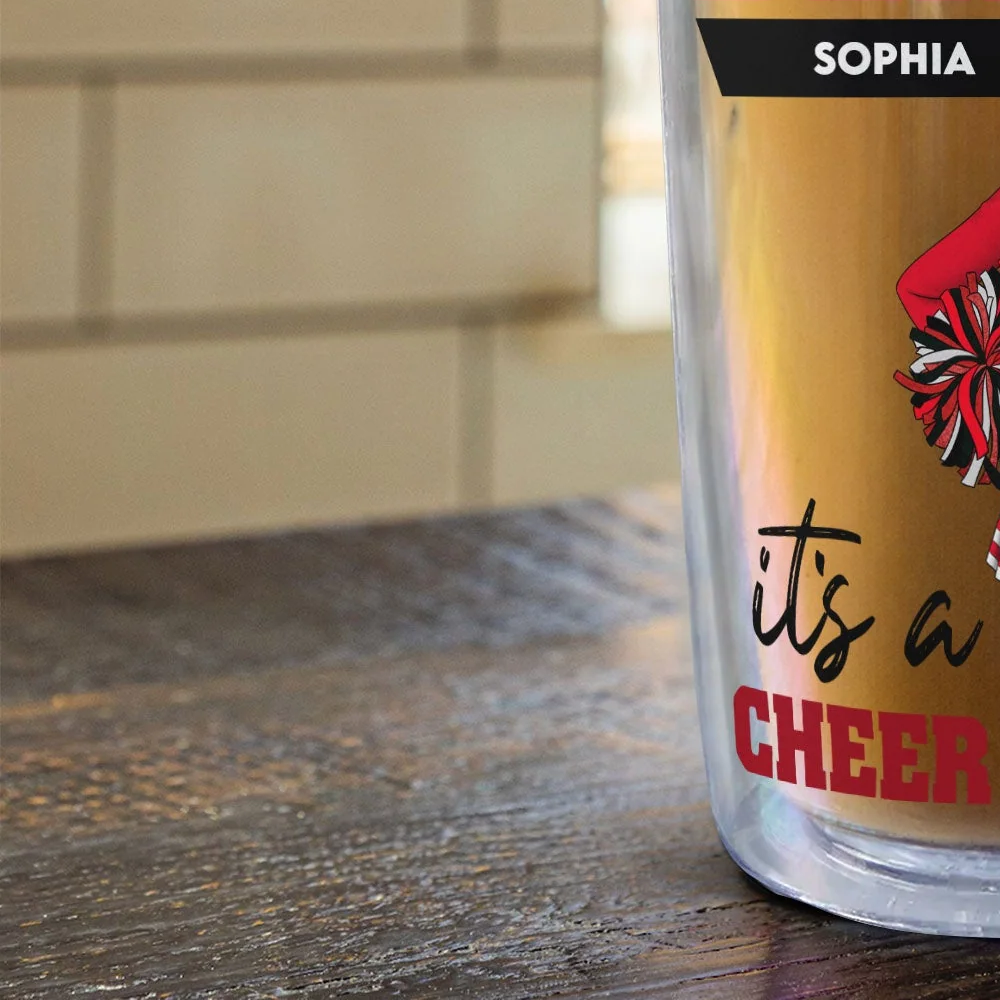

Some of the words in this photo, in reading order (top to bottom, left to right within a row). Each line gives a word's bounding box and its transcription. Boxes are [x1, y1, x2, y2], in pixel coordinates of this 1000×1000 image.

[813, 41, 976, 76] SOPHIA
[752, 498, 875, 683] it's
[903, 589, 984, 667] a
[733, 685, 991, 804] CHEER
